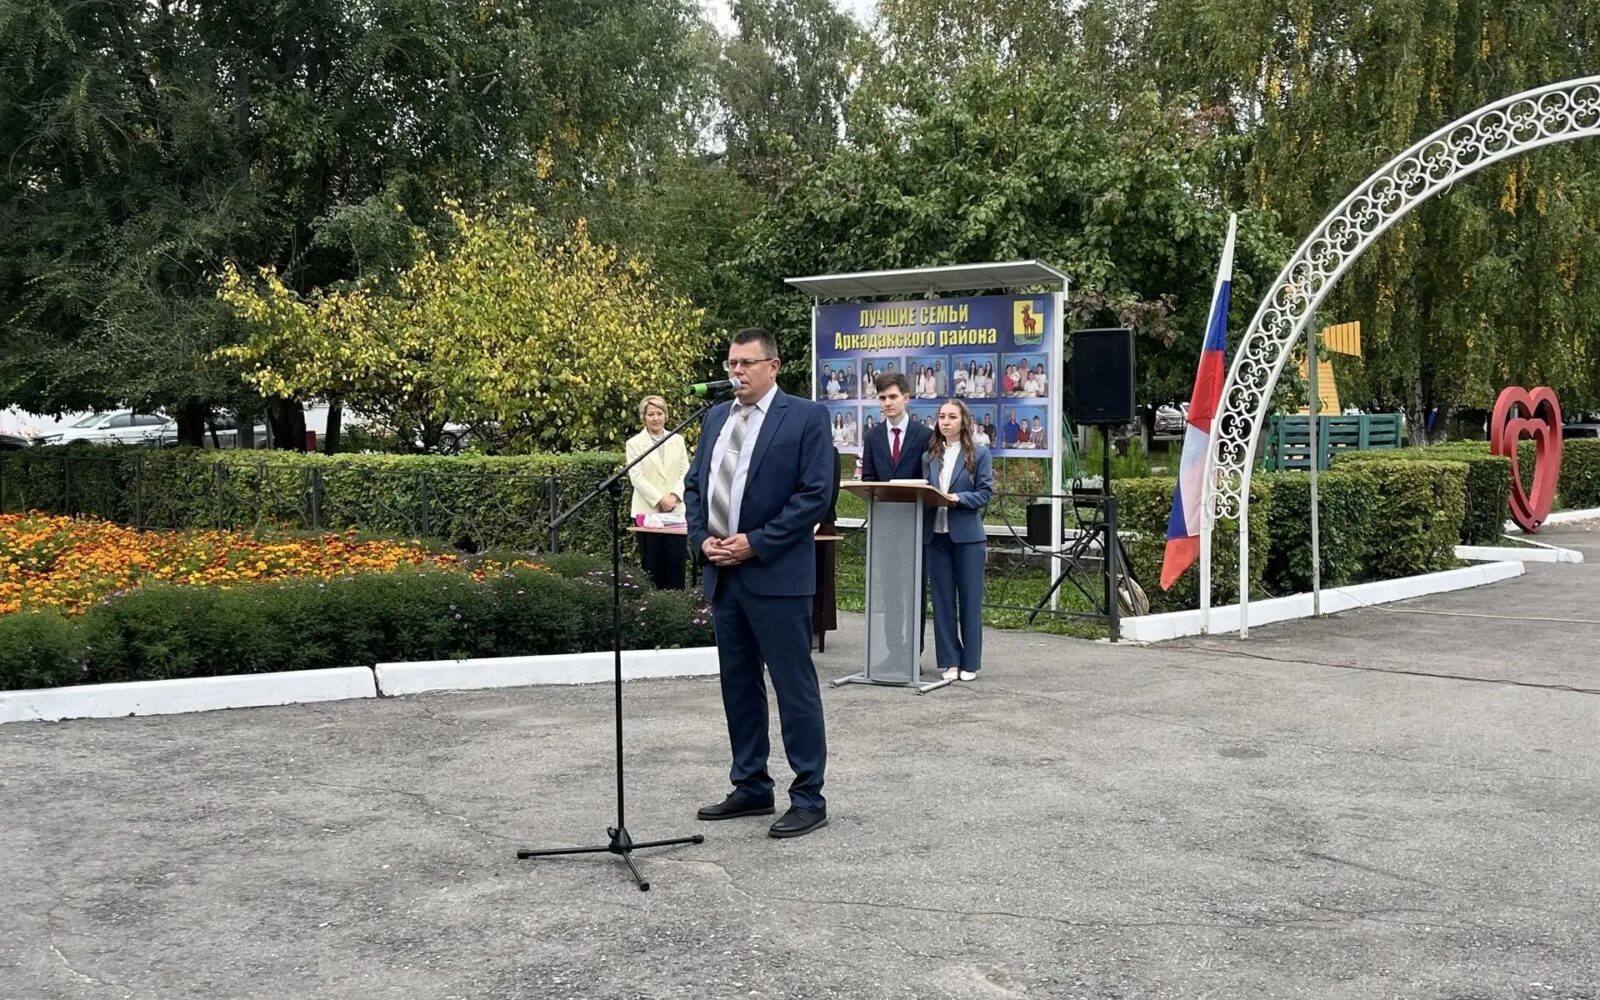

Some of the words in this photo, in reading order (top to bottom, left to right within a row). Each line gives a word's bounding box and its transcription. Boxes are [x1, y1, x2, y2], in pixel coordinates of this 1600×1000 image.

[859, 307, 916, 327] ЛУЧШИЕ
[920, 304, 969, 325] СЕМЬИ
[834, 330, 935, 351] Аркадакского
[939, 326, 997, 347] района
